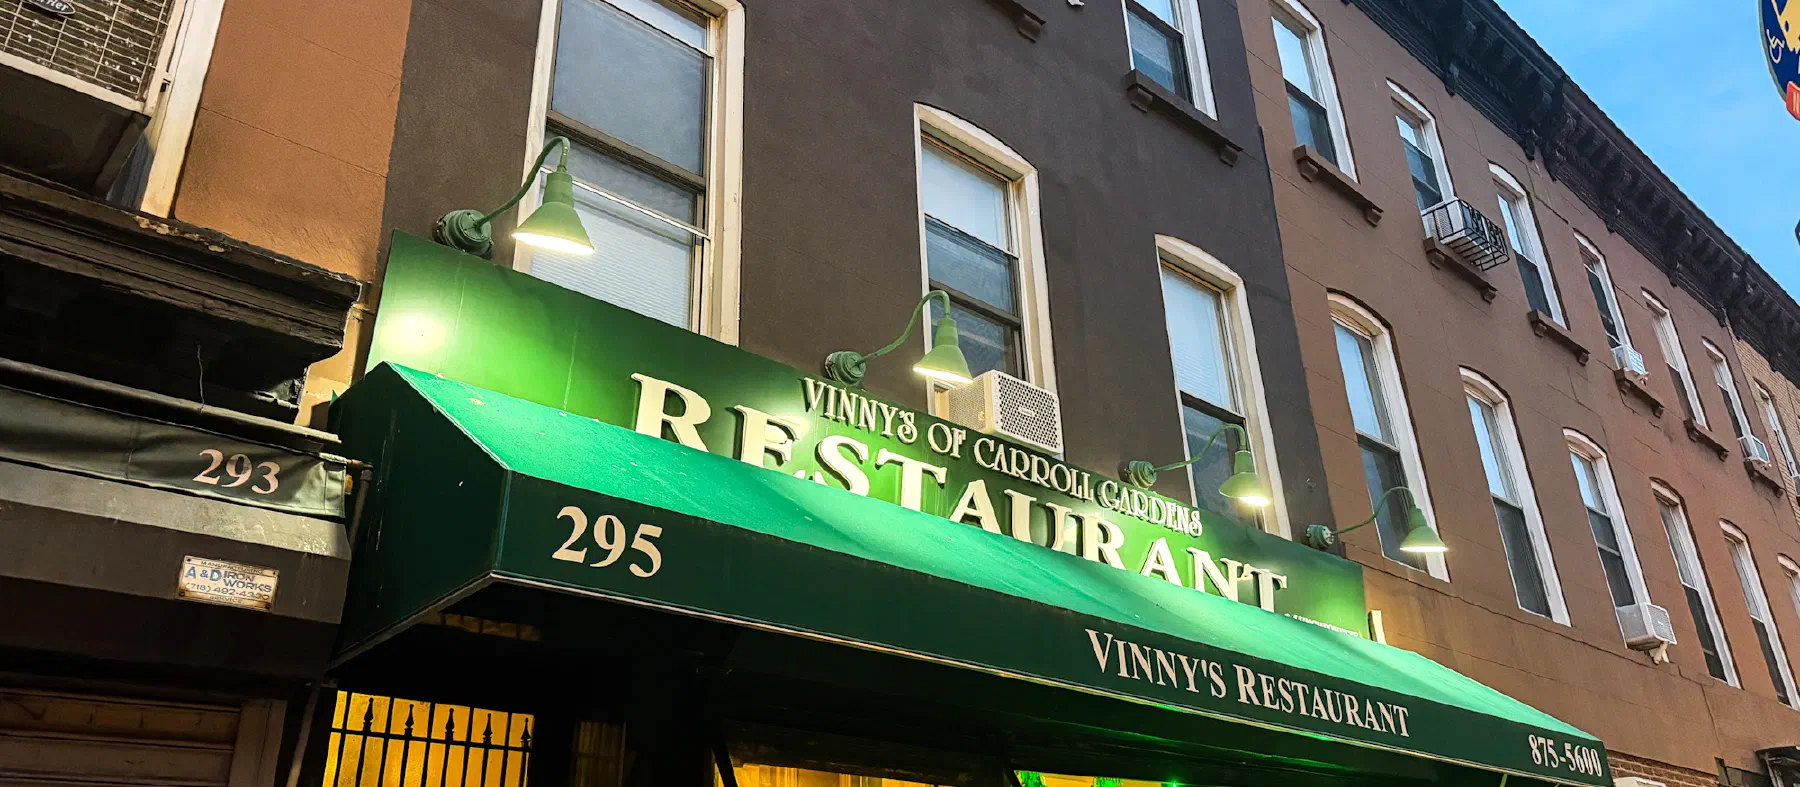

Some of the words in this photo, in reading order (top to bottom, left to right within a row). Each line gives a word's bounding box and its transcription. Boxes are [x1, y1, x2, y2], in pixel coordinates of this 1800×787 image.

[192, 448, 280, 494] 293
[803, 377, 918, 444] VINNY'S
[927, 423, 967, 458] OF
[974, 437, 1094, 501] CARROLL
[1099, 480, 1203, 537] GARDENS
[631, 373, 1287, 613] RESTAURANT
[552, 505, 662, 577] 295
[185, 566, 197, 579] A
[223, 570, 256, 582] IRON
[185, 582, 212, 593] (718)
[223, 579, 272, 593] WORKS
[1085, 628, 1227, 699] VINNY'S
[1232, 664, 1409, 737] RESTAURANT
[1528, 734, 1602, 777] 875-5600
